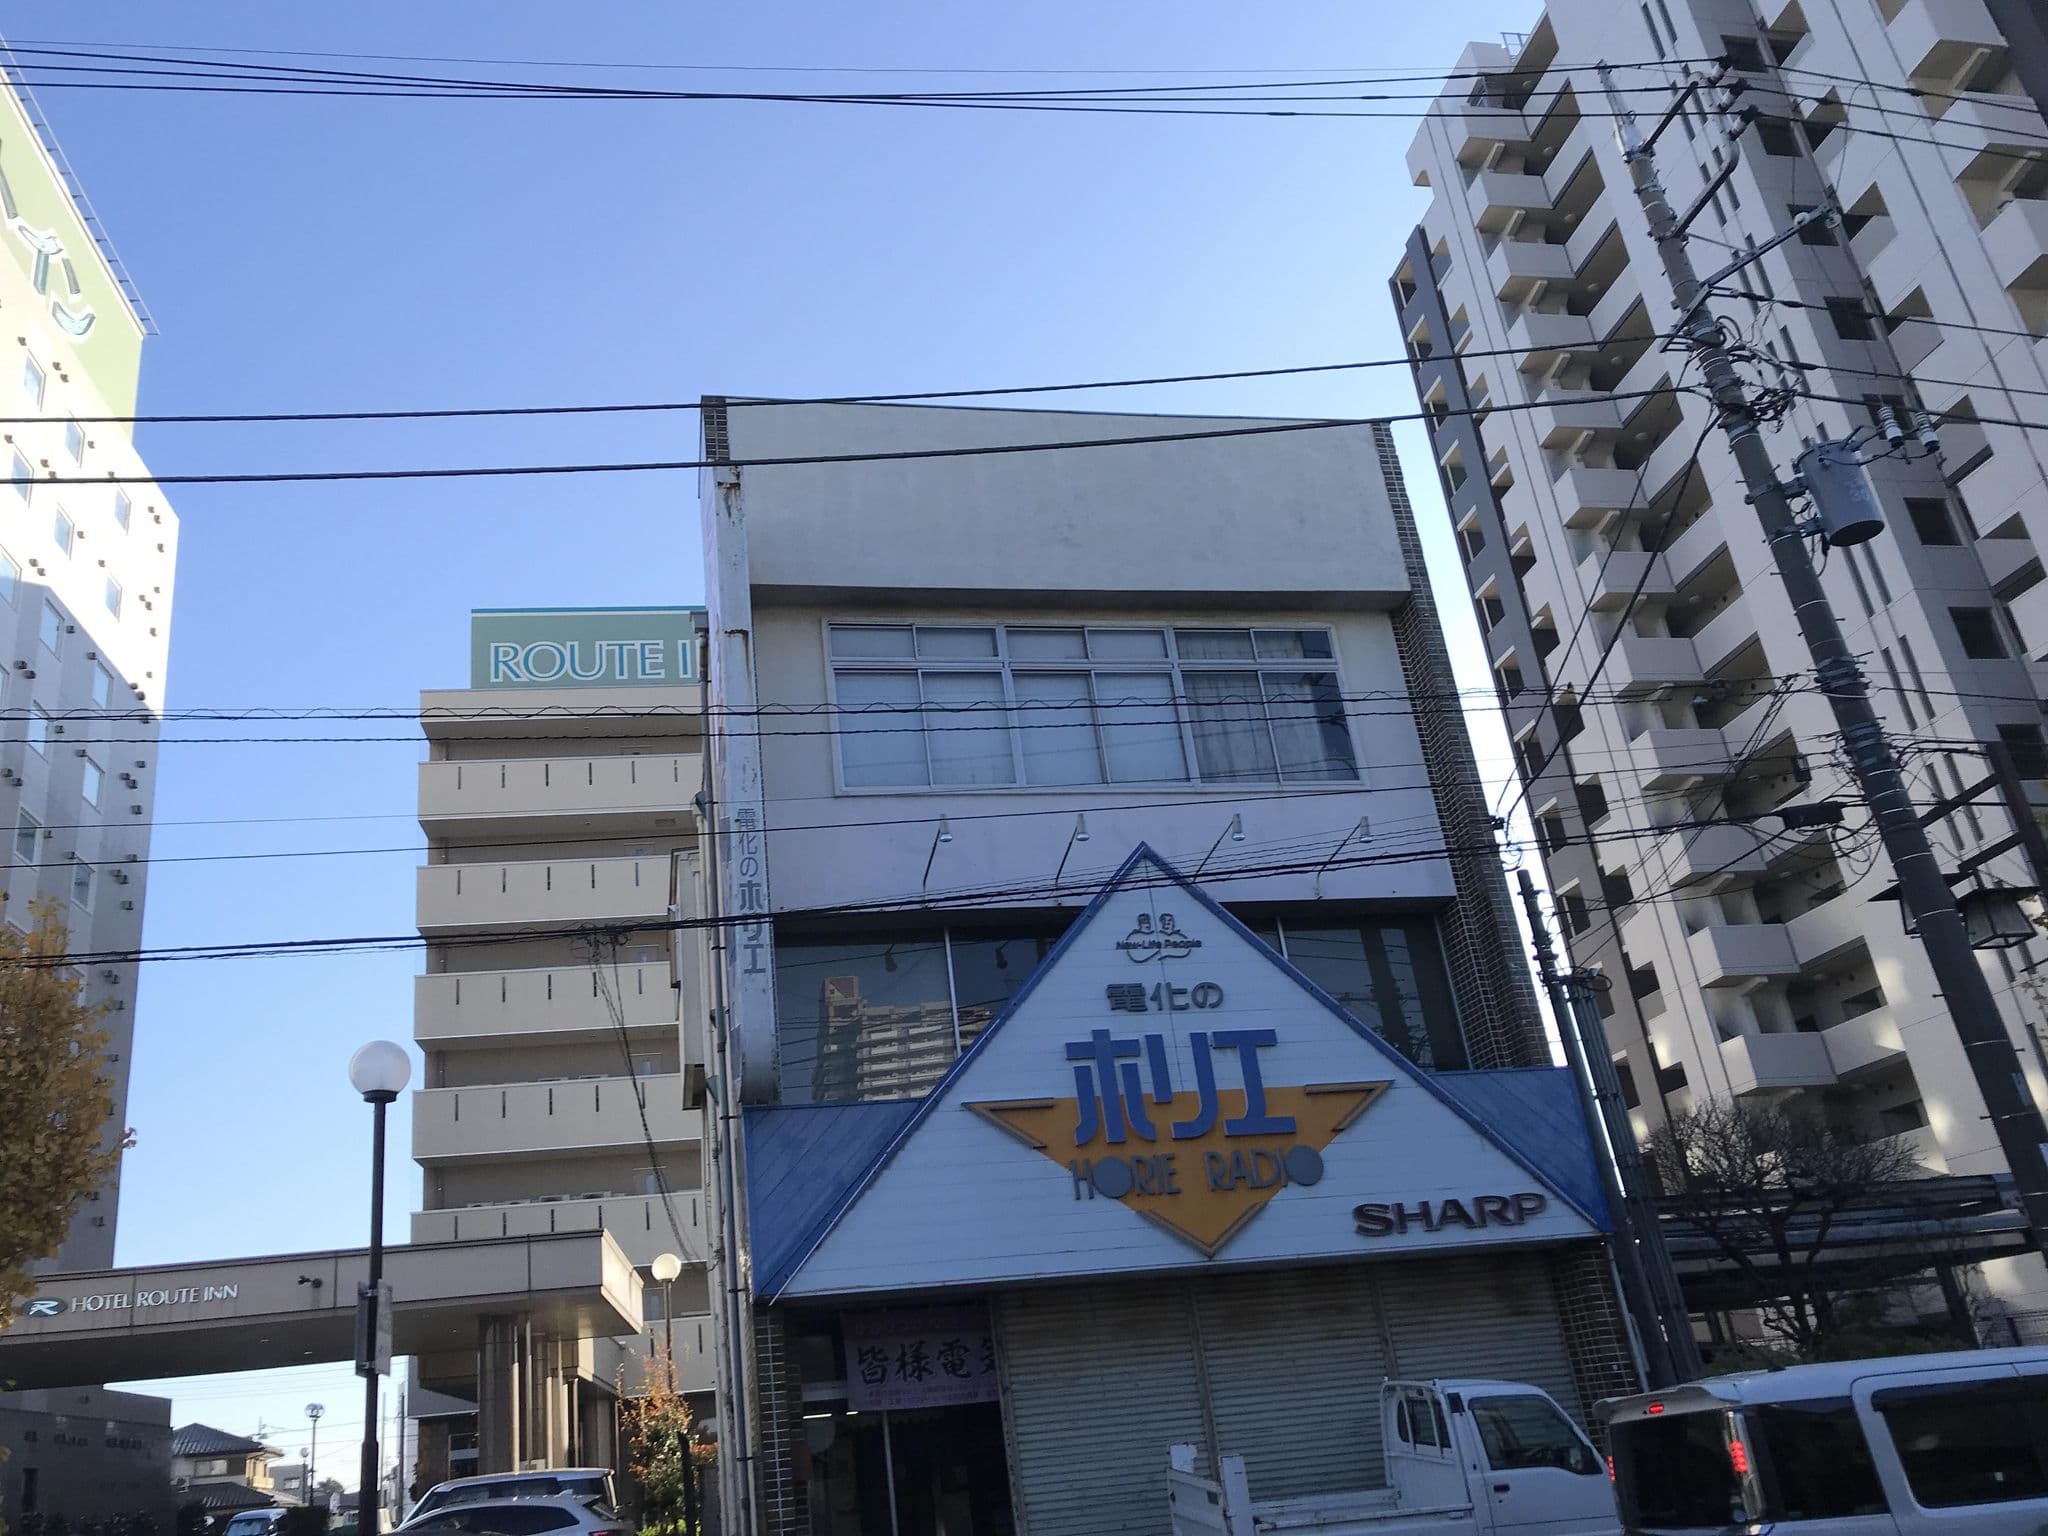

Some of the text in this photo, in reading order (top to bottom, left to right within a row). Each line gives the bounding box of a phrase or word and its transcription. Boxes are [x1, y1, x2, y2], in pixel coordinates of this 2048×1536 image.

[489, 639, 700, 682] ROUTE I
[736, 808, 767, 975] 電化のホリエ
[1164, 937, 1202, 950] People
[1106, 981, 1224, 1012] 電化の
[1065, 1028, 1296, 1147] ホリエ
[1071, 1145, 1324, 1200] HORIE RADIO
[1353, 1192, 1548, 1237] SHARP
[71, 1293, 132, 1313] HOTEL
[136, 1287, 200, 1308] ROUTE
[203, 1284, 239, 1302] INN
